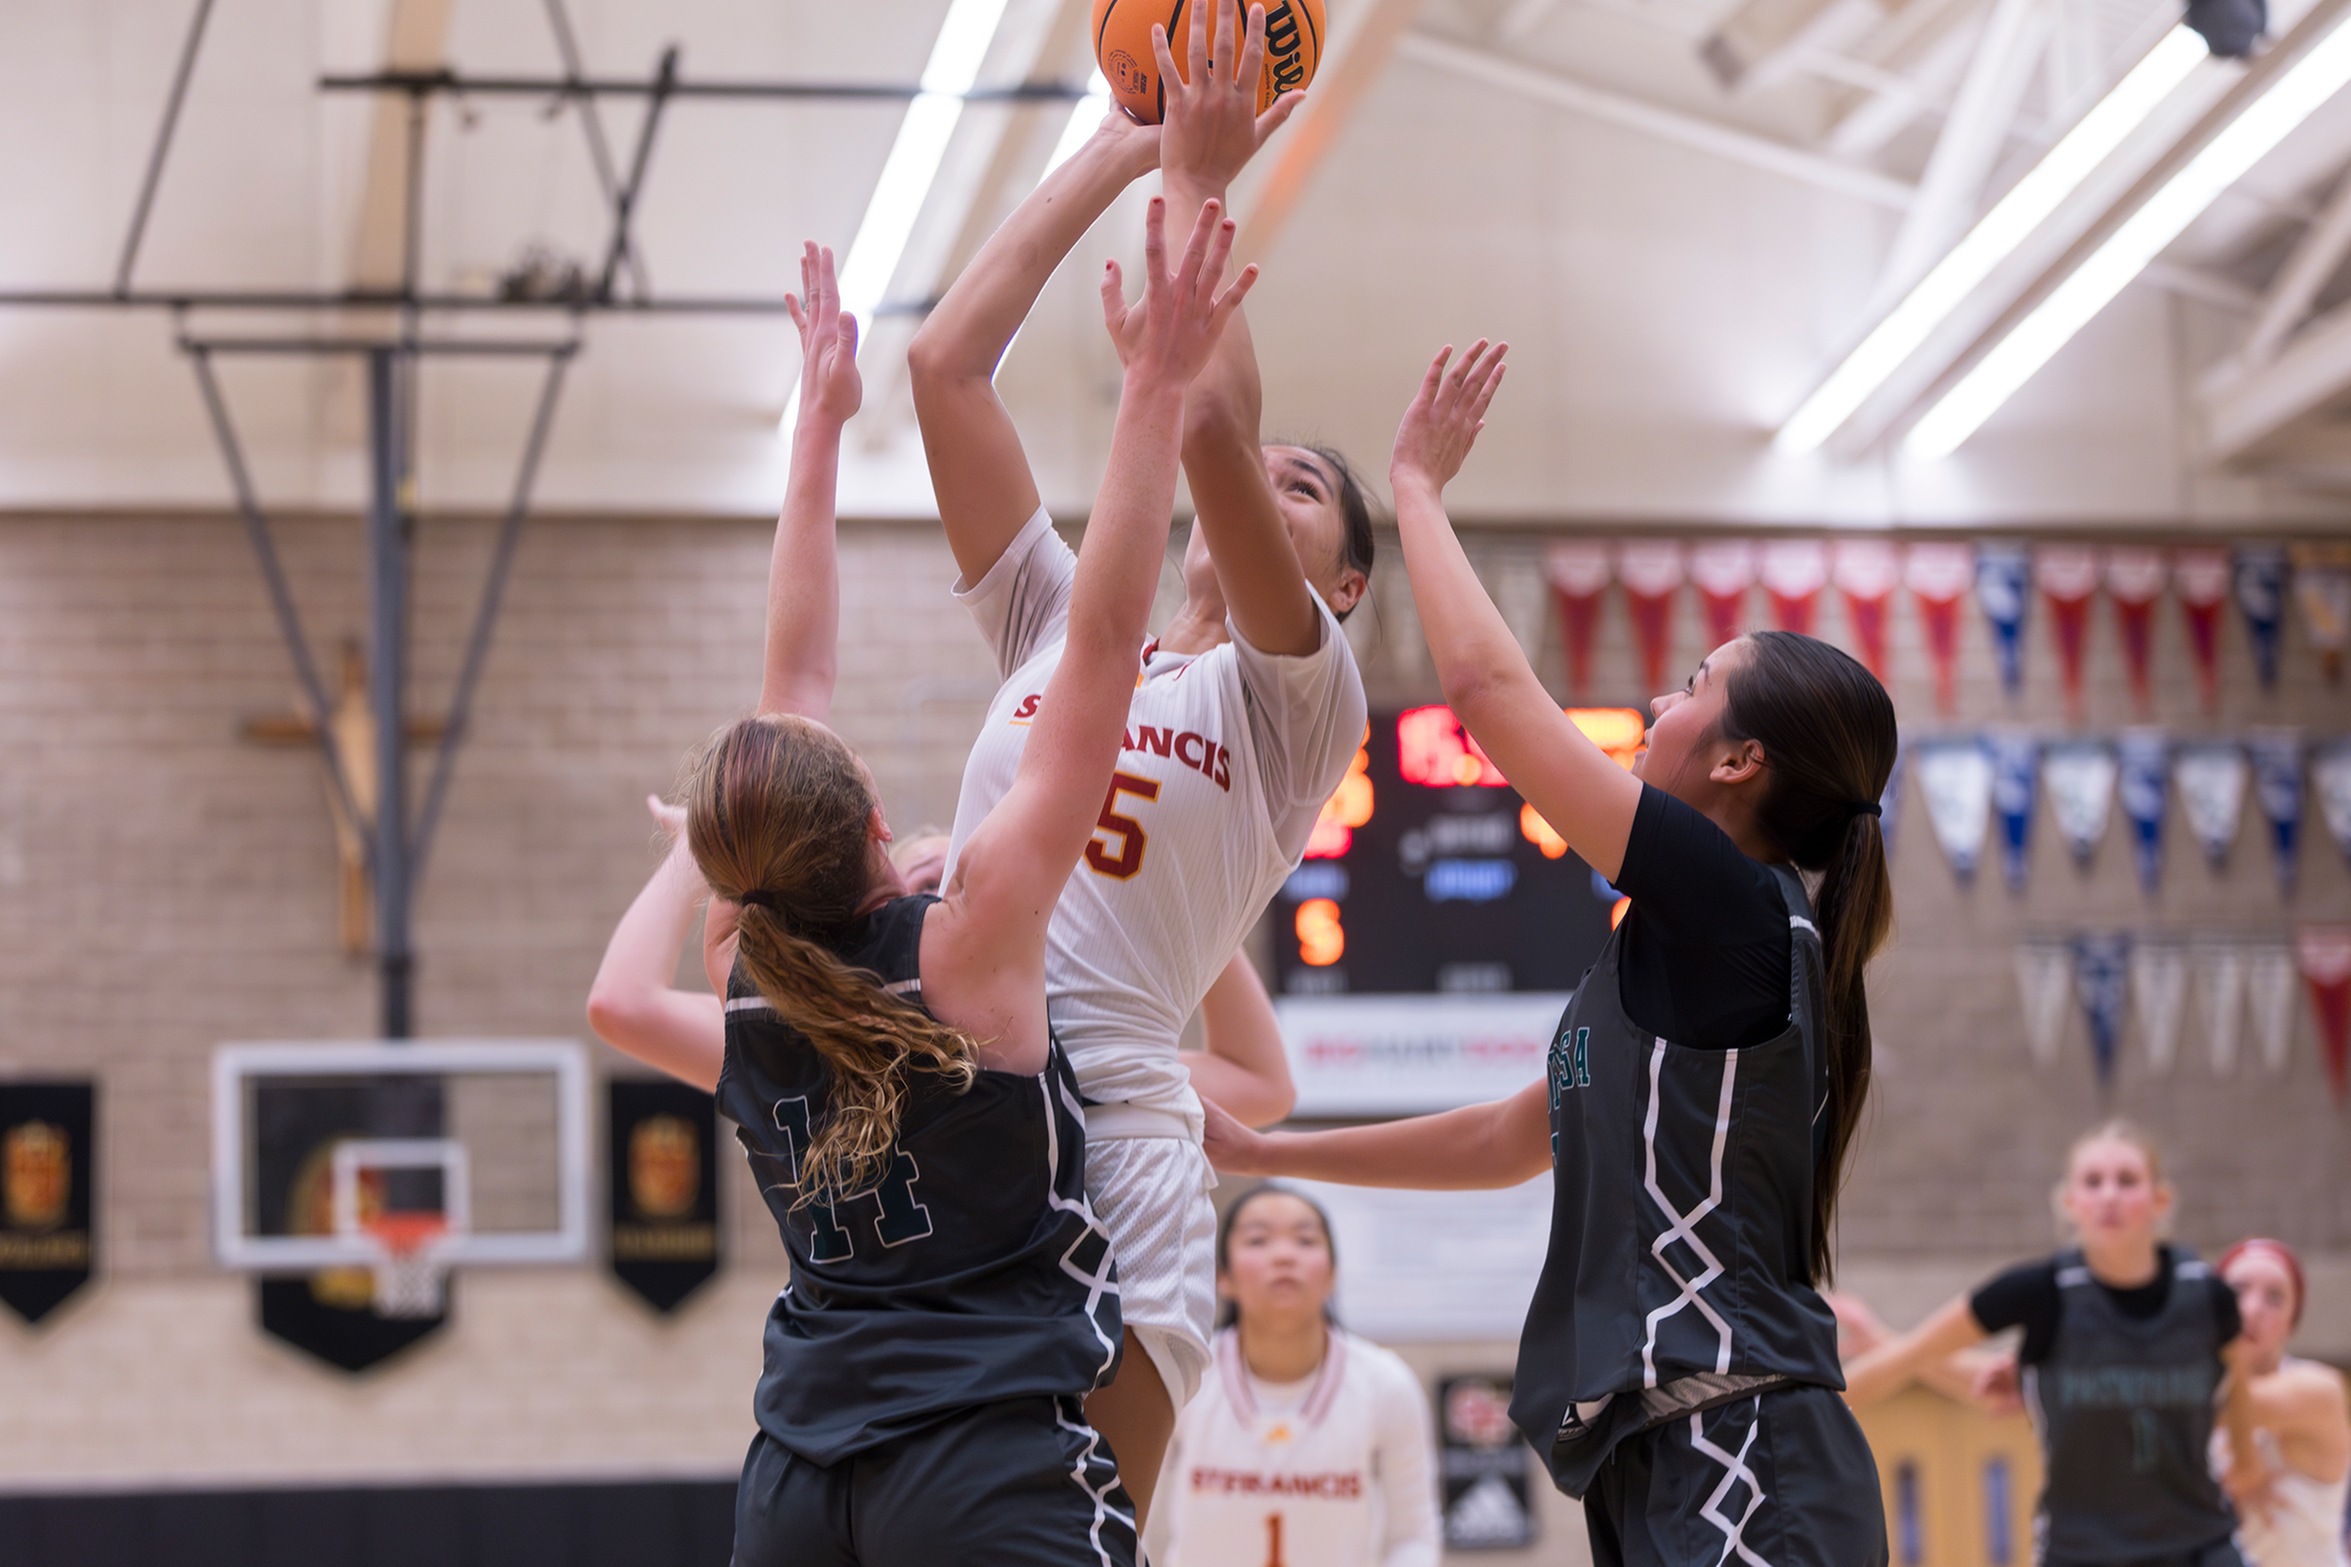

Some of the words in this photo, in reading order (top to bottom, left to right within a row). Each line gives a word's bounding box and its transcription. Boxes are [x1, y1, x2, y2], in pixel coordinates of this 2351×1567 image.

[1264, 0, 1304, 105] Wil
[1014, 694, 1042, 718] S
[1083, 770, 1162, 881] 5
